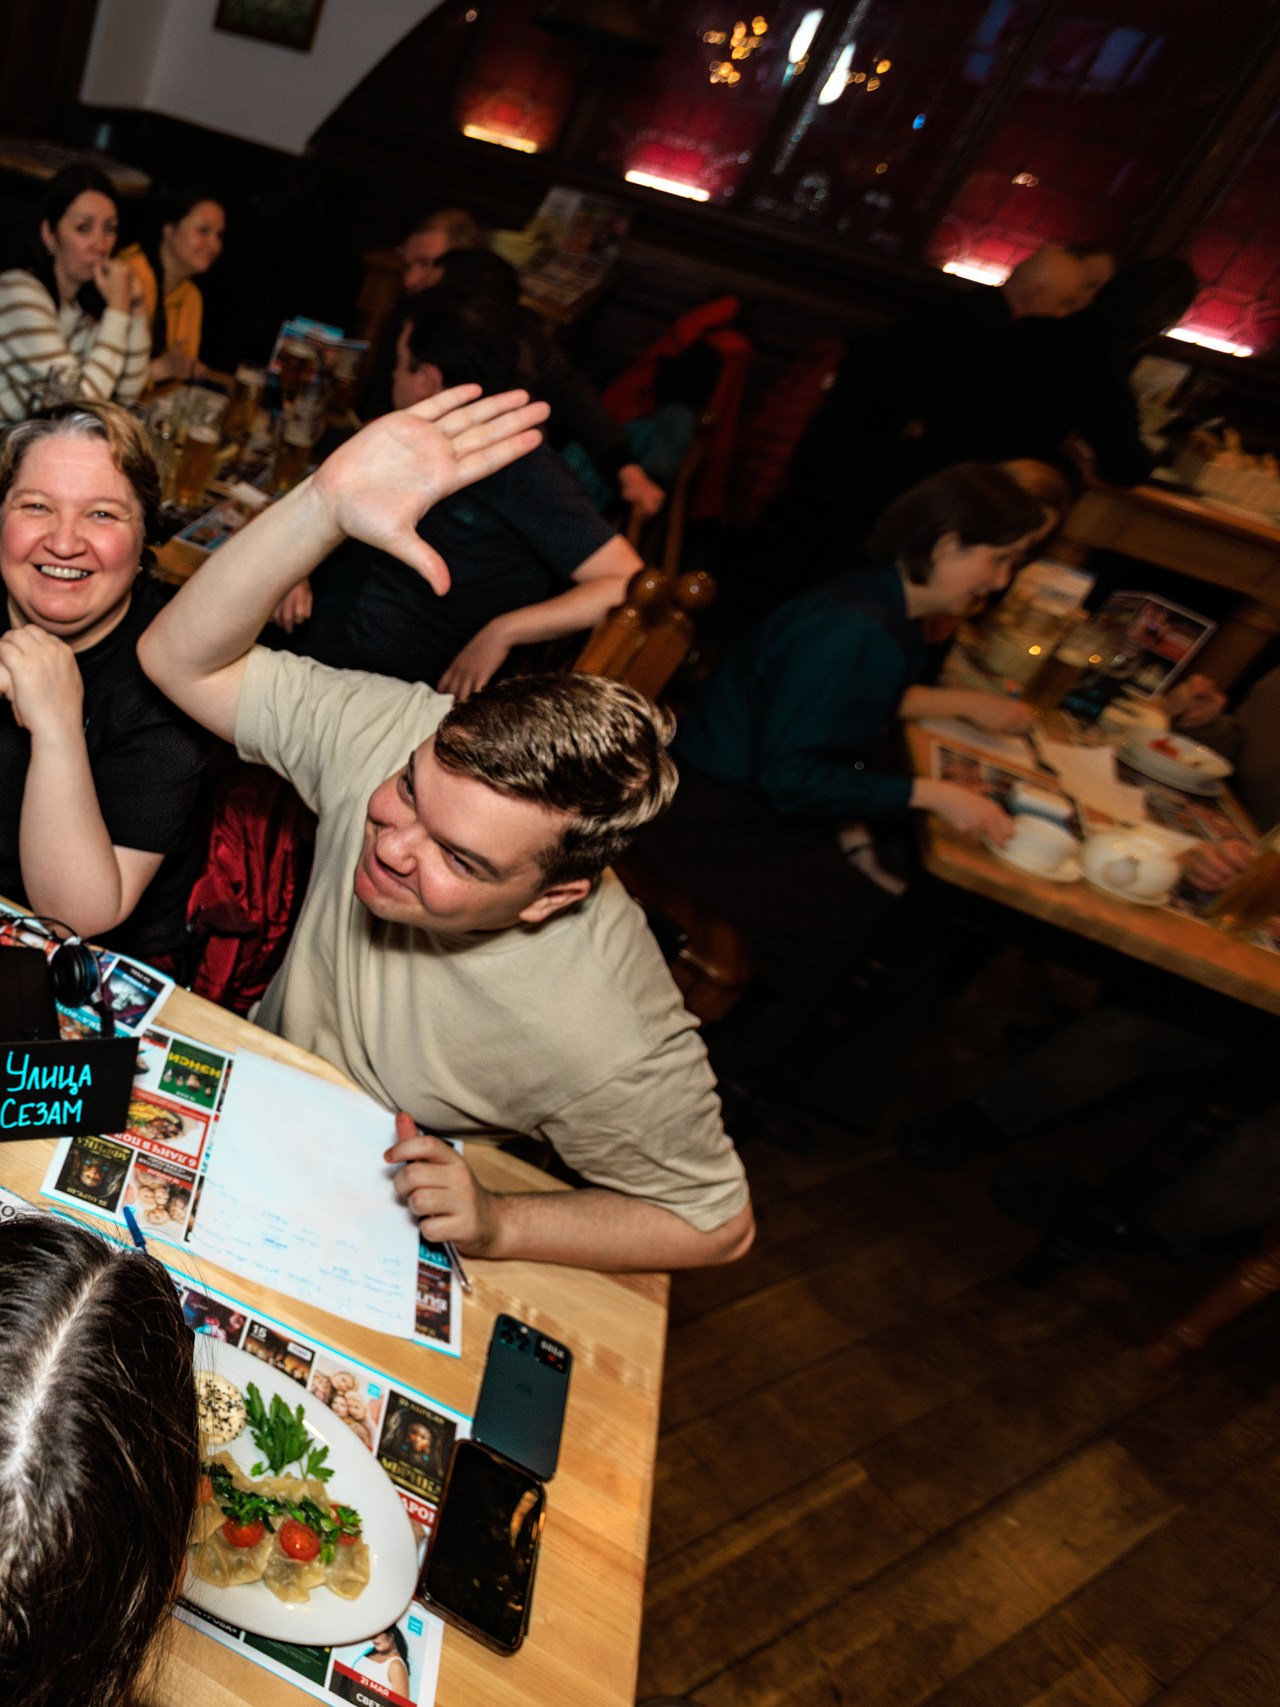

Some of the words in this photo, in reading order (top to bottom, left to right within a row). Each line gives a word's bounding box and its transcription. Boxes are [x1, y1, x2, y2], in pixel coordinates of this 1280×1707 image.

[6, 1051, 91, 1095] УЛИЦА
[167, 1051, 222, 1080] НЭНСИ
[0, 1098, 82, 1128] СЕЗАМ
[142, 1139, 152, 1150] В
[151, 1143, 187, 1163] ЛАНЧ
[188, 1157, 197, 1166] 6
[360, 1676, 369, 1686] 21
[369, 1681, 390, 1697] МАЯ
